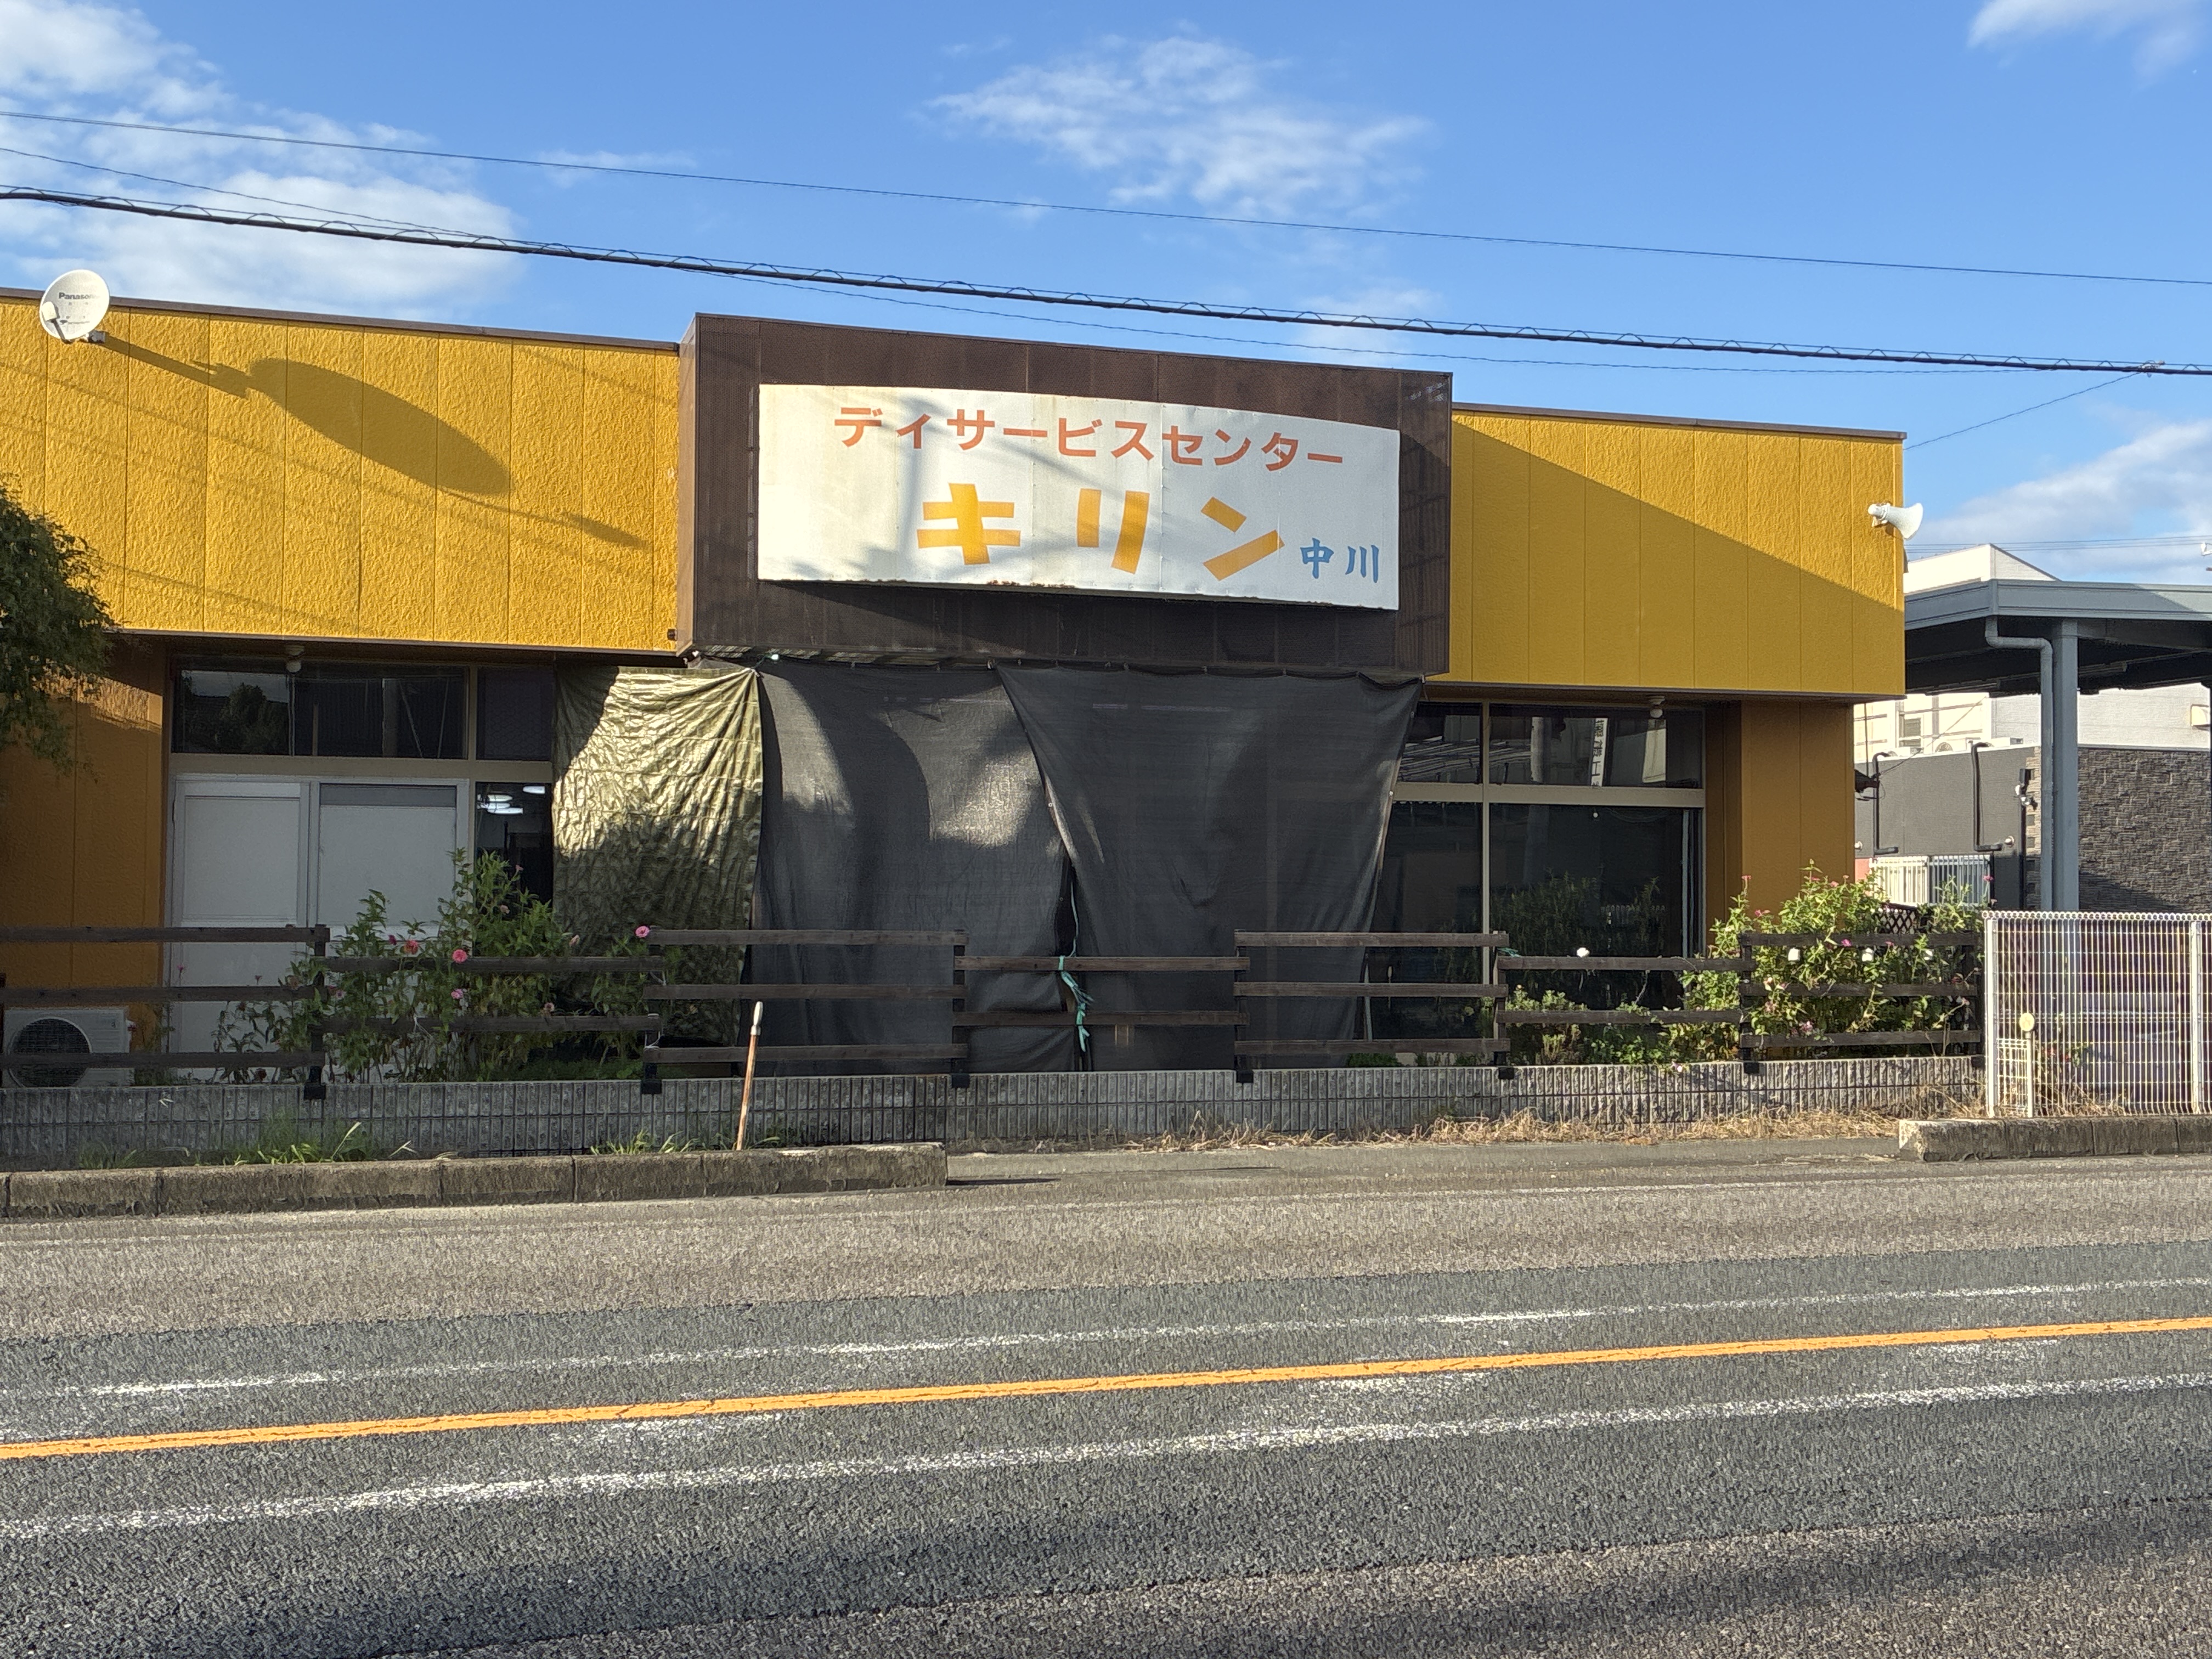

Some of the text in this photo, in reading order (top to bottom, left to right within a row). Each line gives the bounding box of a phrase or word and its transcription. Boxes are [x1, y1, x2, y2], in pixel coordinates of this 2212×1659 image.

[58, 292, 100, 300] Panason
[917, 482, 1380, 584] キリン 中川
